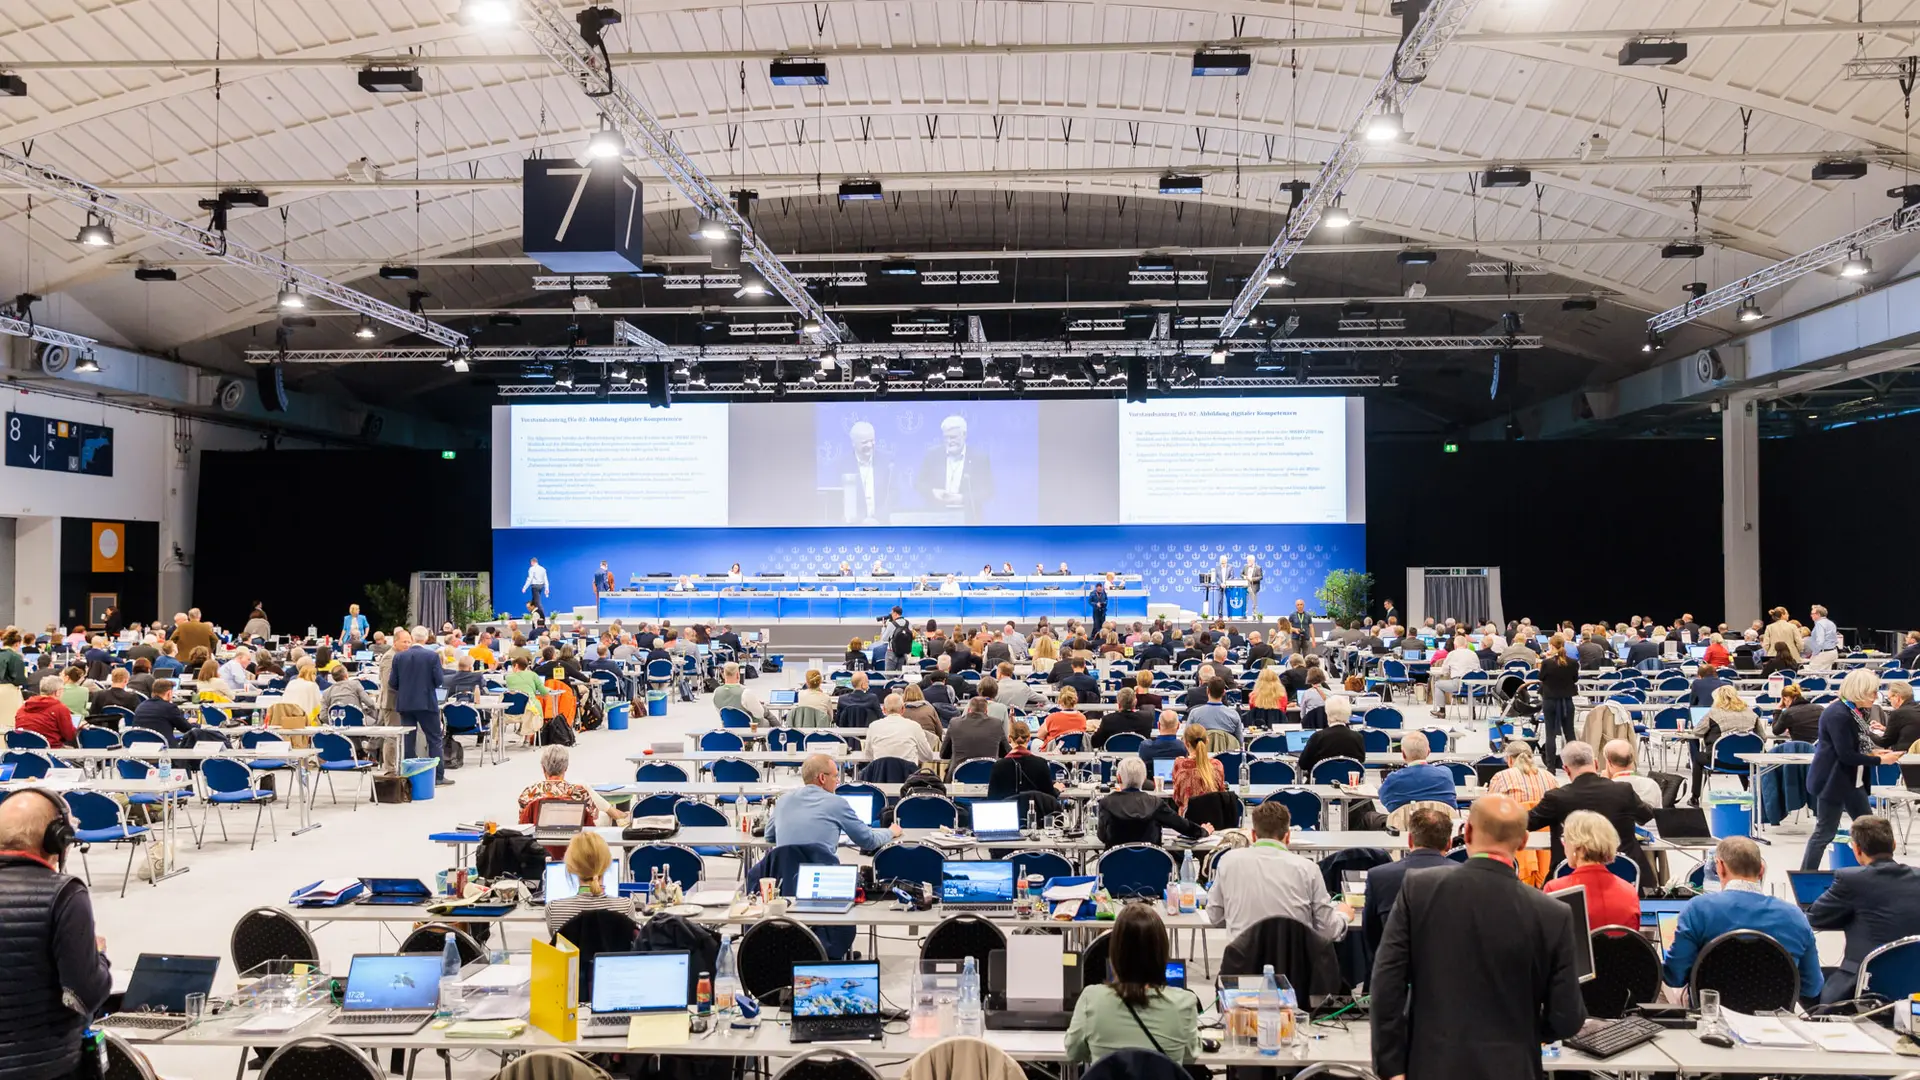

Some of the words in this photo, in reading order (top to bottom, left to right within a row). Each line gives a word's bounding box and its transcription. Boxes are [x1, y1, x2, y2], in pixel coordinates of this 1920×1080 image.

[546, 168, 592, 242] 7
[623, 175, 637, 249] 7
[10, 418, 21, 441] 8
